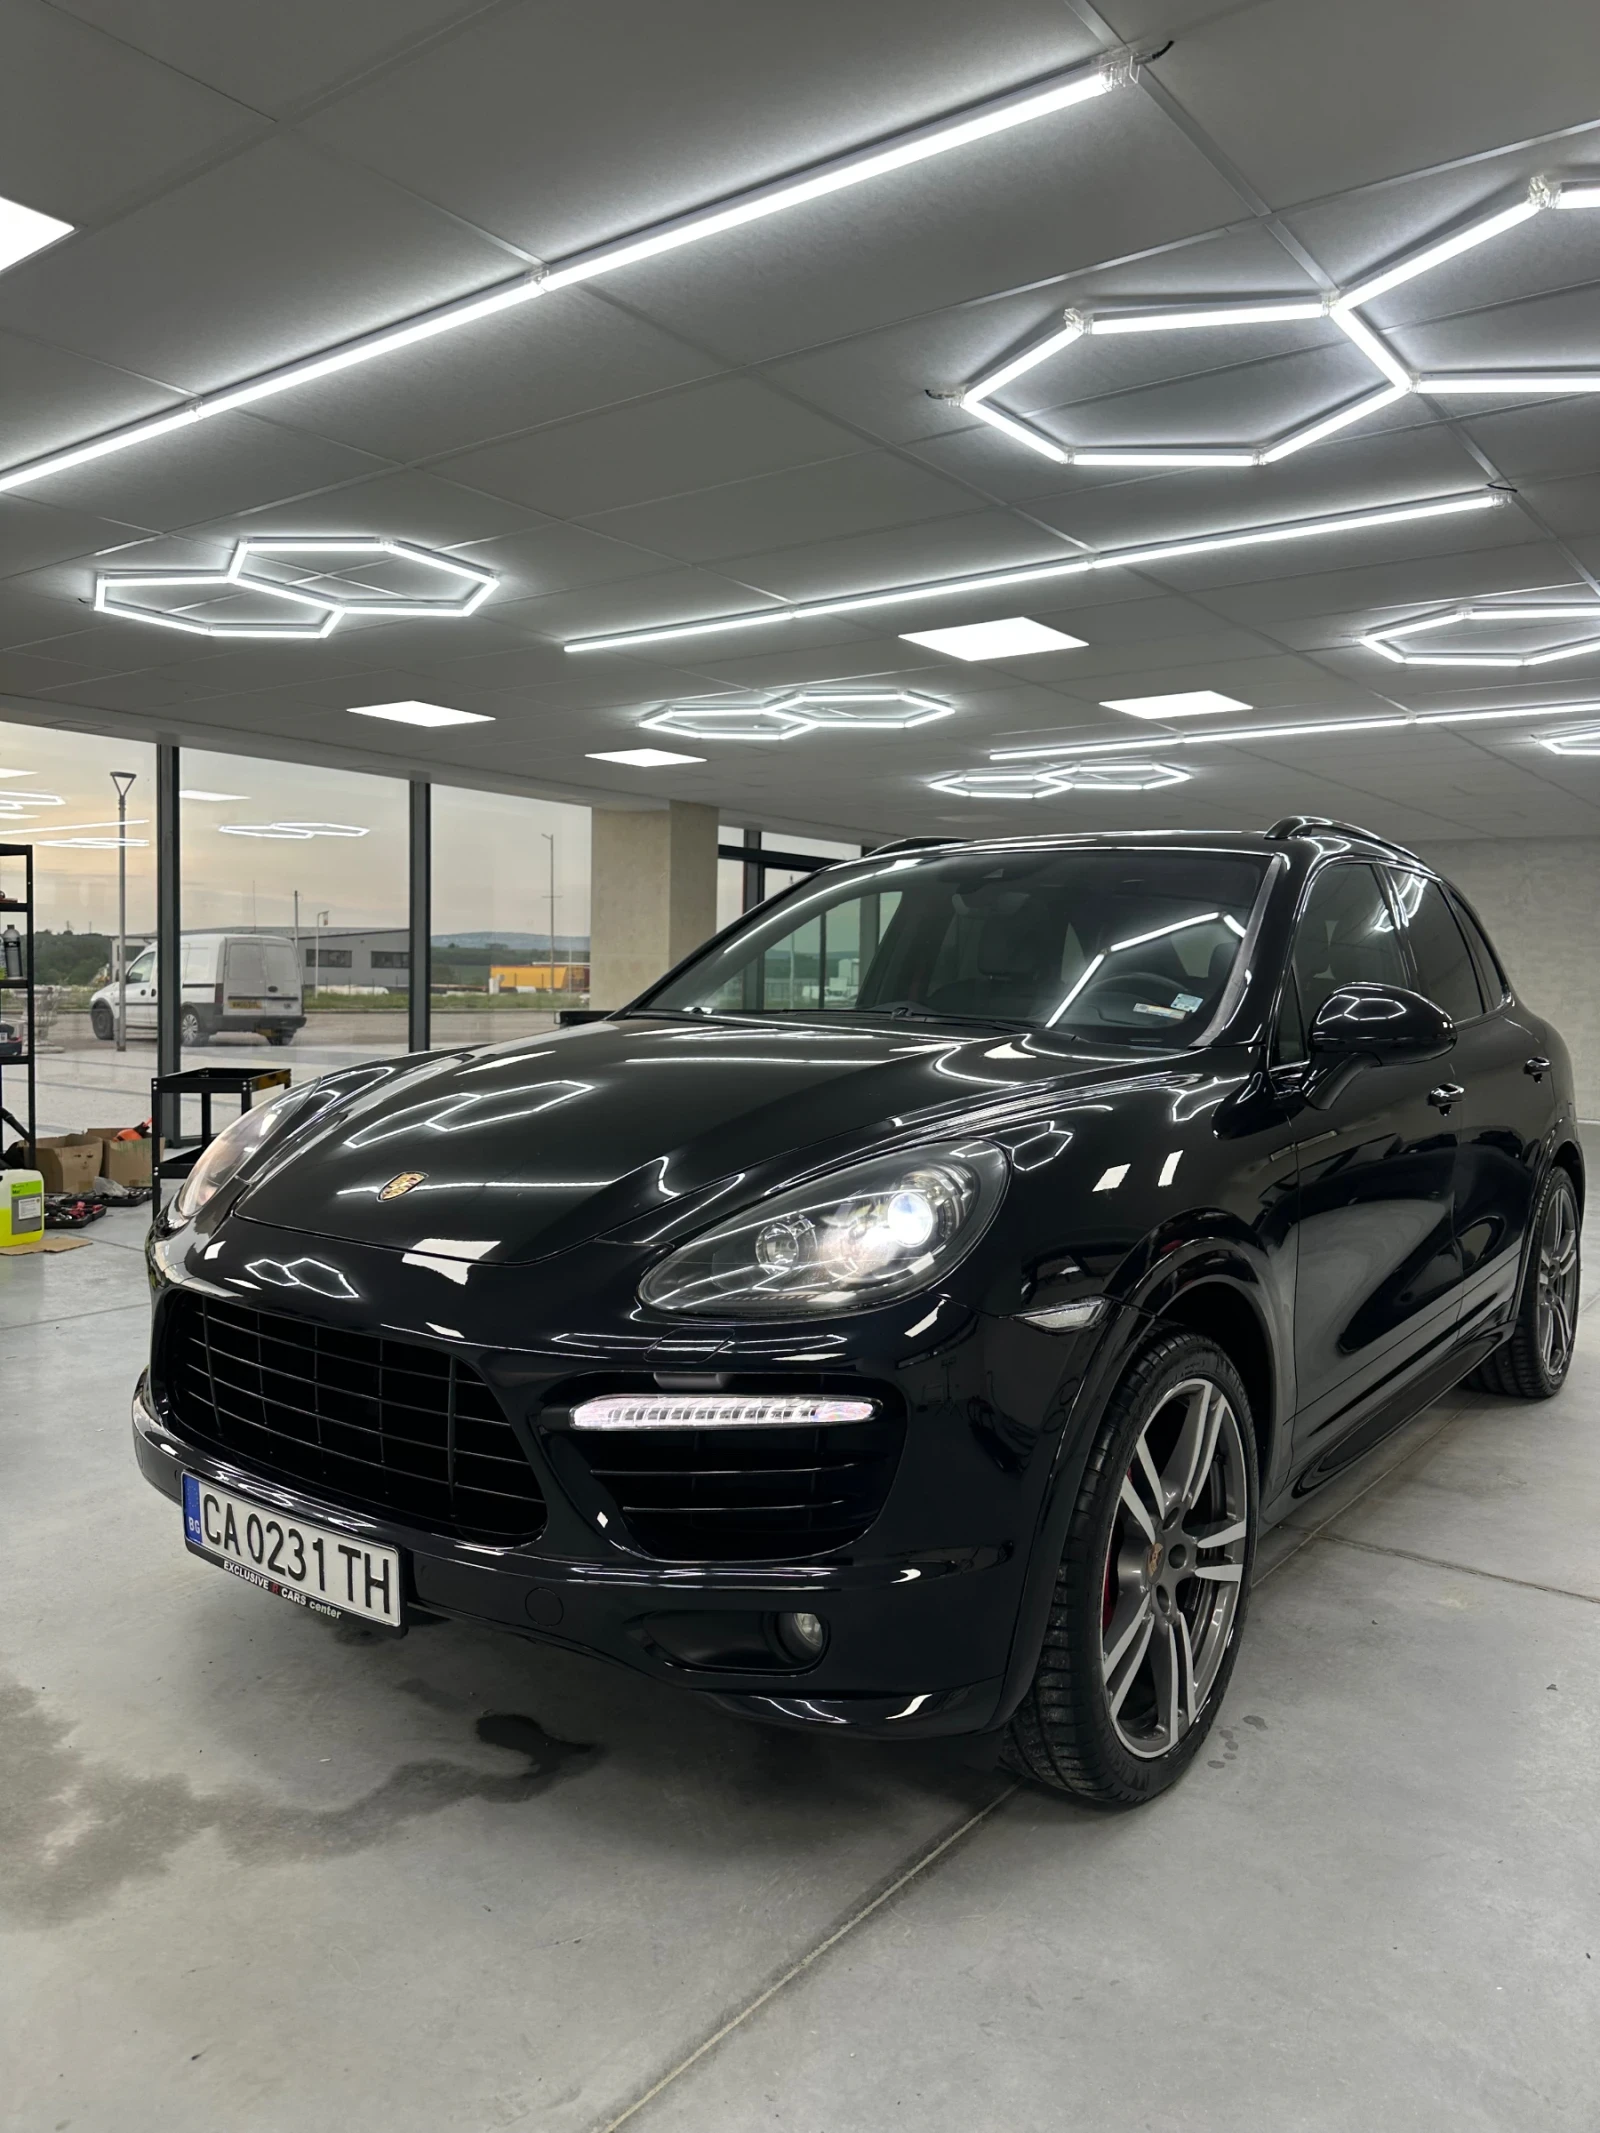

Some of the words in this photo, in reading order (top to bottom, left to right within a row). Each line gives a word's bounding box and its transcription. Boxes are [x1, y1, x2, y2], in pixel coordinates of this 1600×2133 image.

[188, 1516, 201, 1535] BG
[203, 1493, 241, 1556] CA
[246, 1512, 325, 1592] 0231
[338, 1544, 391, 1614] TH
[223, 1560, 269, 1590] EXCLUSIVE
[281, 1587, 307, 1606] CARS
[309, 1600, 342, 1619] center
